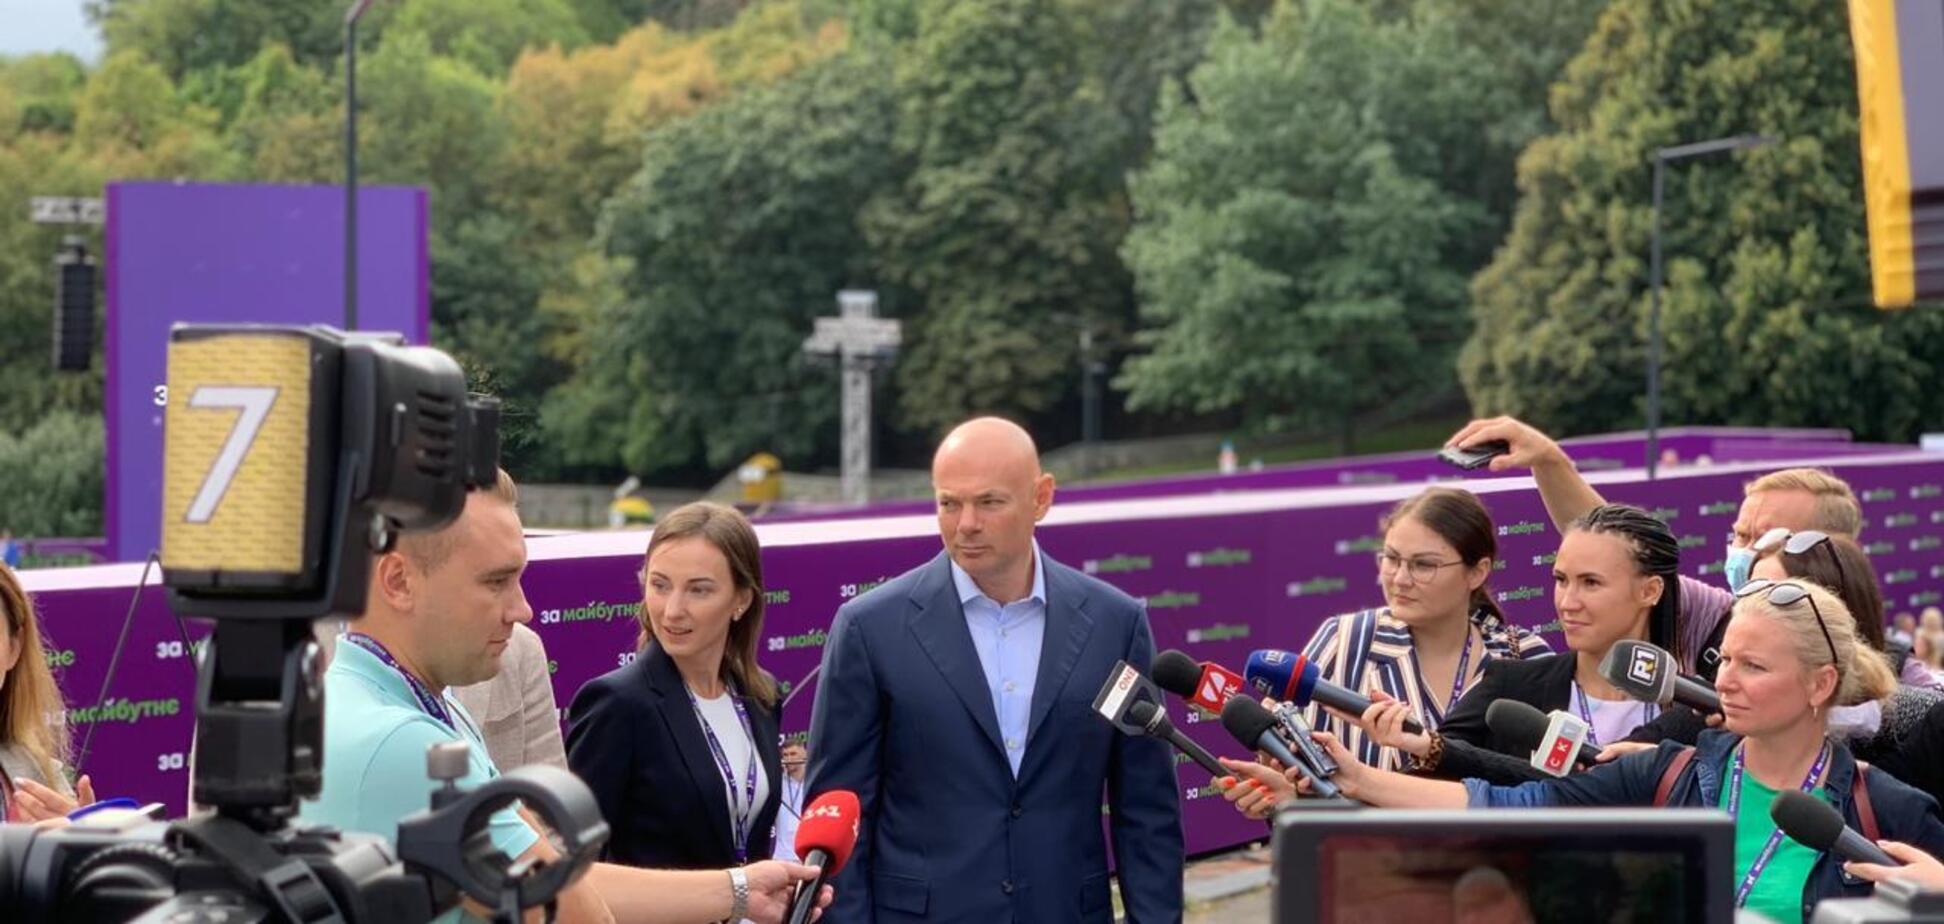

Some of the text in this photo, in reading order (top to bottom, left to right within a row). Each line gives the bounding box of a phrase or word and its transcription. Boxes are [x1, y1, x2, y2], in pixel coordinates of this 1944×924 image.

[184, 386, 280, 524] 7
[541, 609, 560, 624] за
[156, 641, 183, 659] за
[768, 636, 785, 651] за
[1633, 649, 1657, 682] R1
[1118, 665, 1137, 691] ONE
[69, 698, 180, 724] майбутнє
[157, 753, 184, 771] за
[802, 804, 841, 823] 1+1
